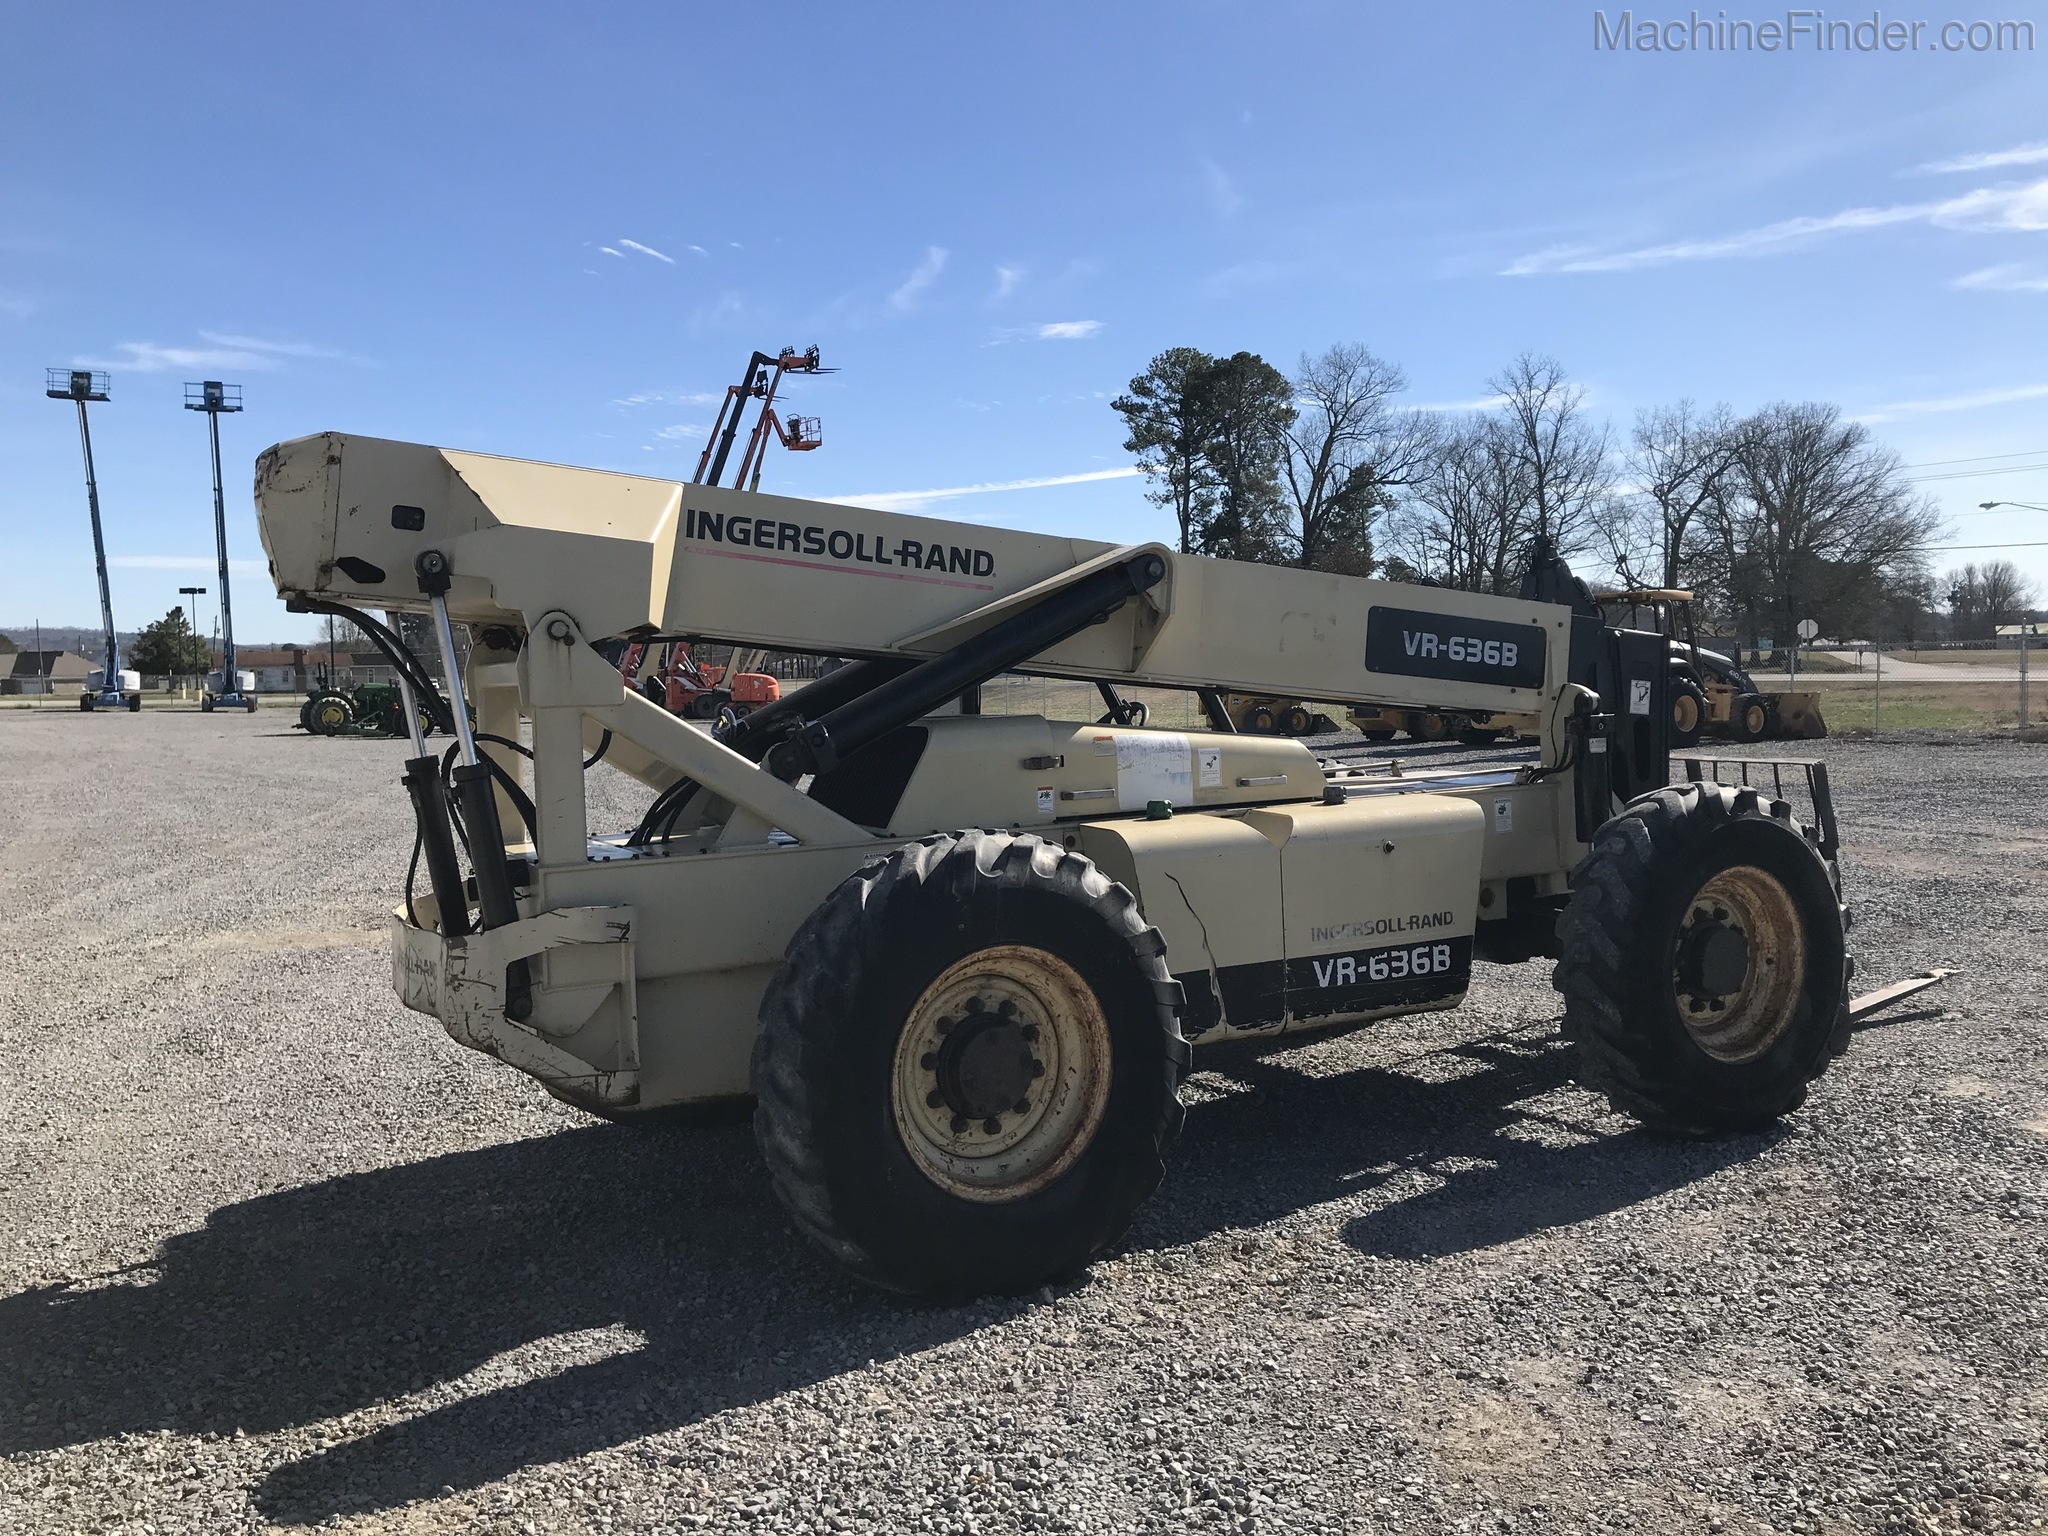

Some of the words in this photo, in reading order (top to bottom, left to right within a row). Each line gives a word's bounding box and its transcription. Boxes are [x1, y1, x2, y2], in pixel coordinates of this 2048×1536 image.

[685, 509, 996, 578] INGERSOLL-RAND
[1402, 630, 1518, 667] VR-636B
[1312, 944, 1451, 988] VR-636B
